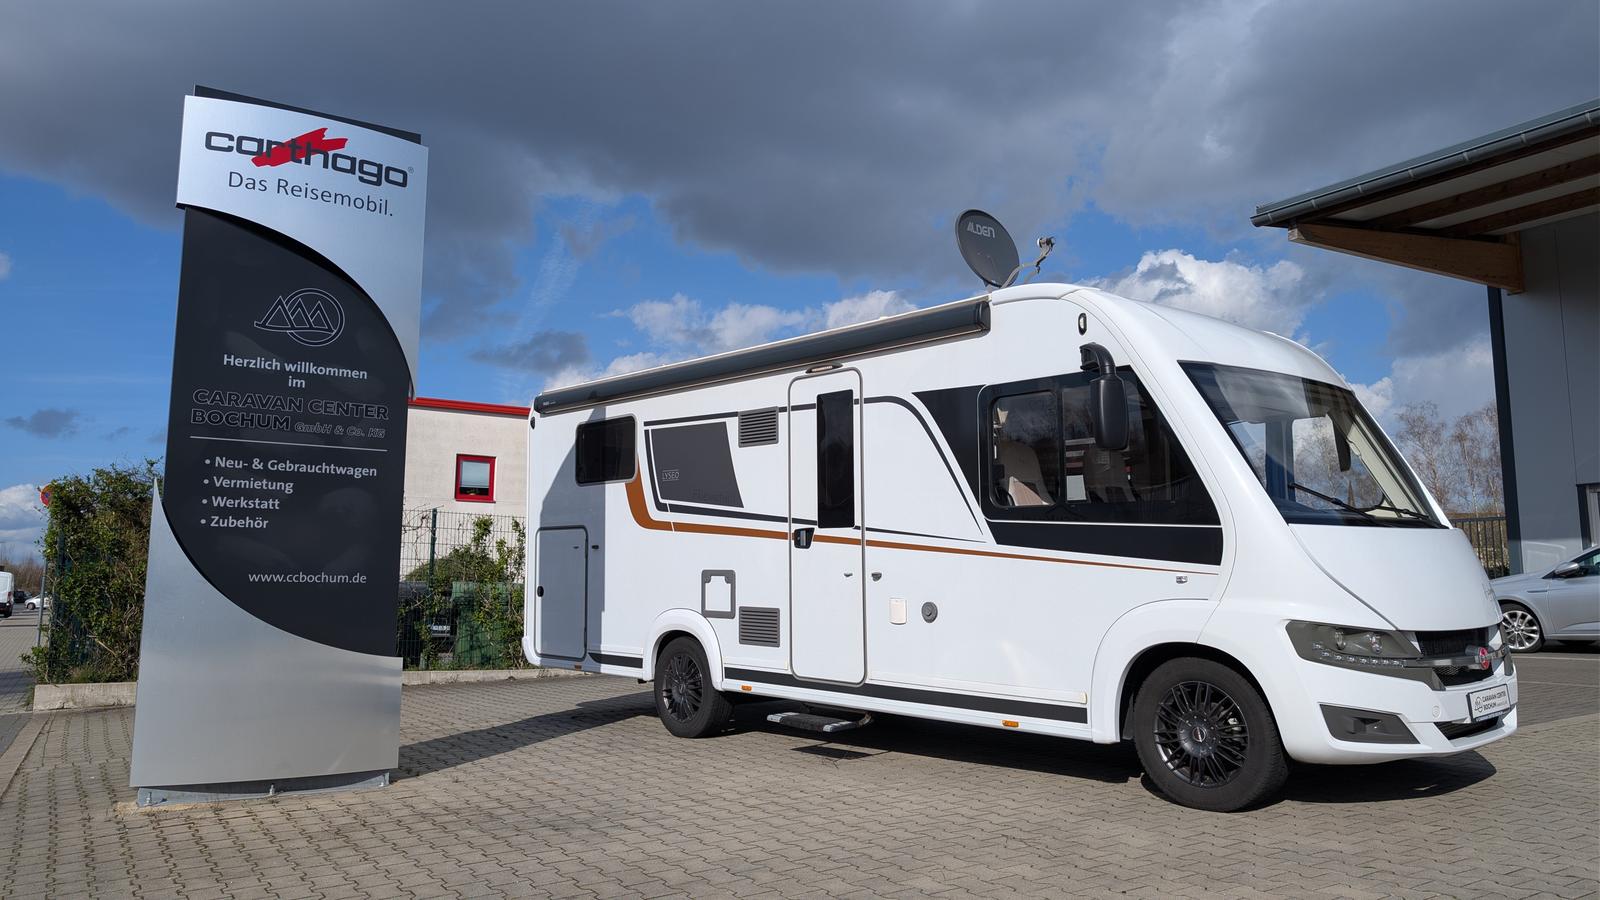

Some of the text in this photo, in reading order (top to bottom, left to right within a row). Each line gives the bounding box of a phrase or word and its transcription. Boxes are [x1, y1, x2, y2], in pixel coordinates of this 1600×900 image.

[205, 131, 408, 187] carthago
[228, 171, 394, 217] Das Reisemobil.
[223, 354, 368, 380] Herzlich willkommen
[288, 375, 306, 389] im
[192, 388, 389, 420] CARAVAN CENTER
[190, 408, 291, 431] BOCHUM
[294, 421, 333, 435] GmbH
[333, 424, 345, 435] &
[346, 425, 366, 437] Co.
[214, 456, 377, 478] Neu- & Gebrauchtwagen
[213, 476, 294, 494] Vermietung
[211, 496, 281, 510] Werkstatt
[210, 515, 269, 529] Zubehör
[248, 571, 367, 584] www.ccbochum.de
